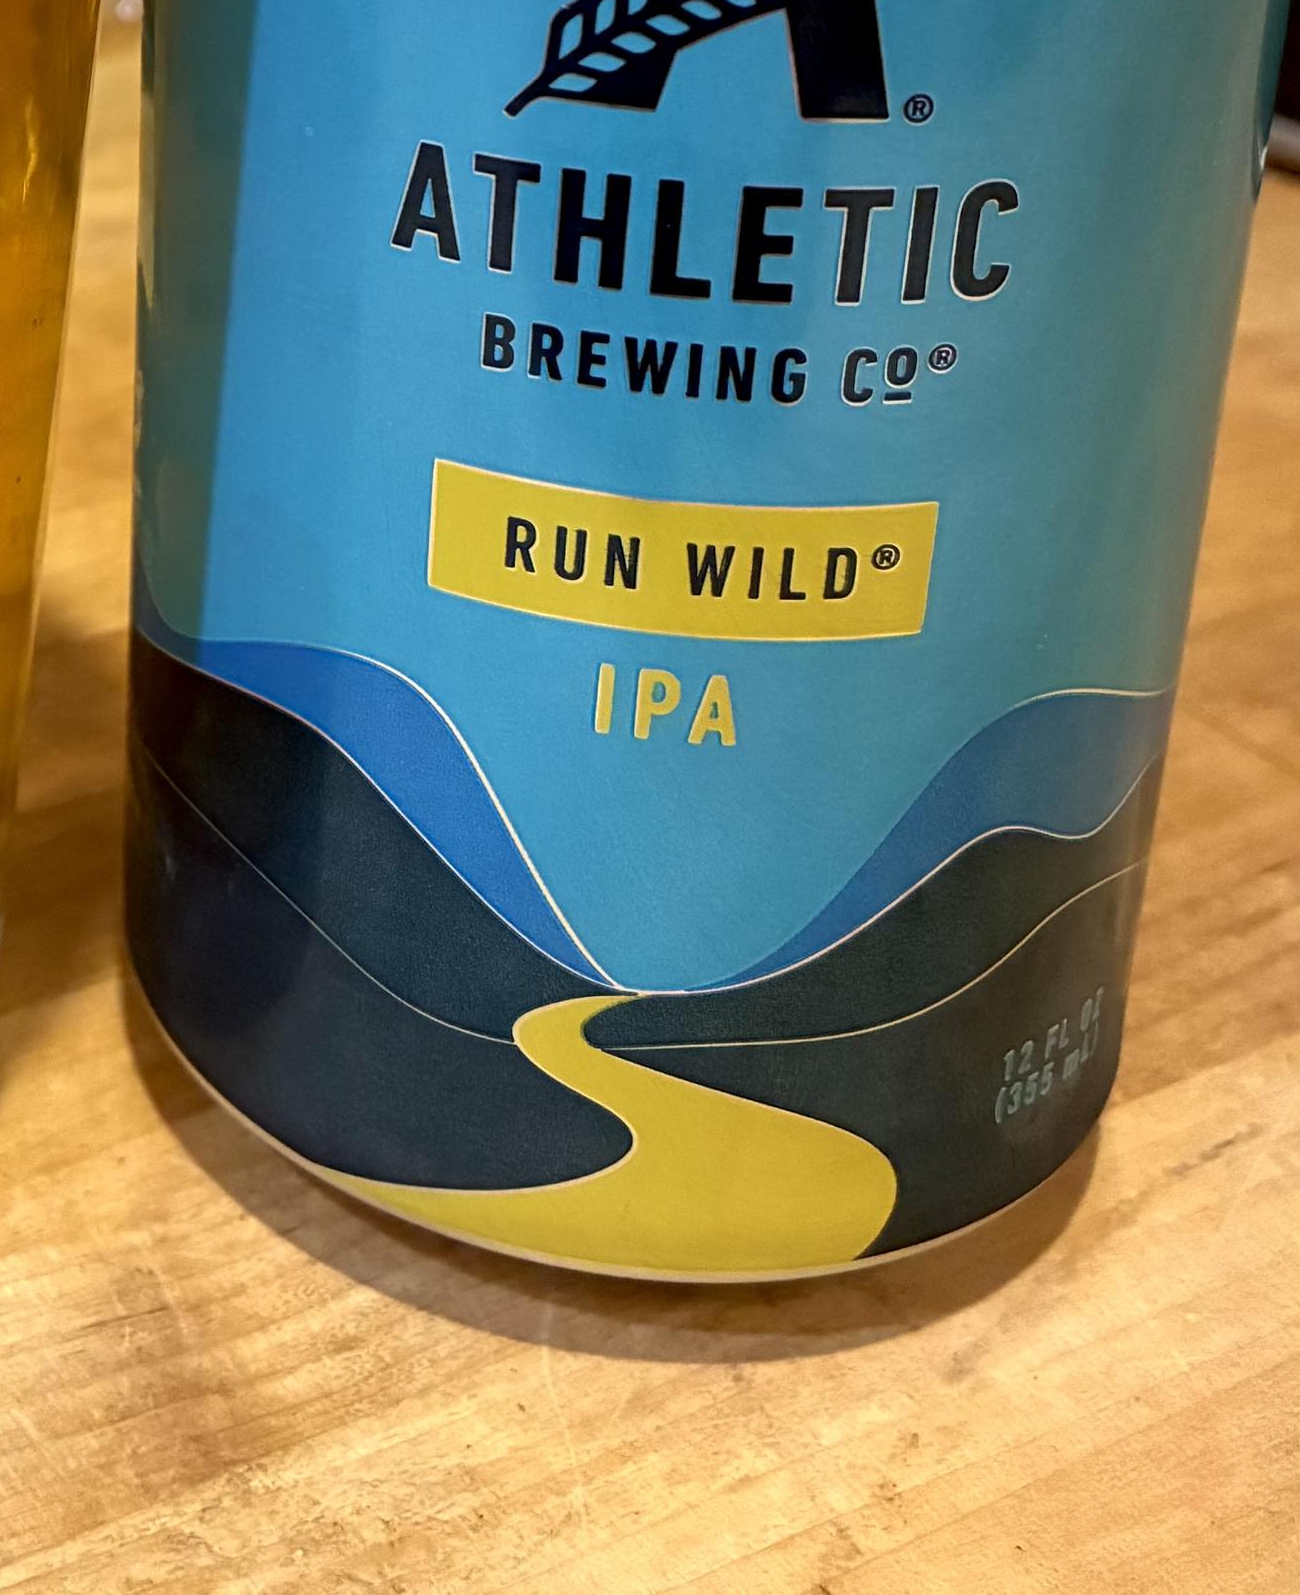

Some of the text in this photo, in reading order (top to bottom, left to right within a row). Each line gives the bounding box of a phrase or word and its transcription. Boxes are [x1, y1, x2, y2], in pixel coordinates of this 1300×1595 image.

[390, 140, 1018, 306] ATHLETIC
[480, 312, 808, 405] BREWING
[504, 516, 641, 590] RUN
[595, 663, 737, 747] IPA
[1003, 1039, 1035, 1082] 12
[1044, 1017, 1070, 1060] FL
